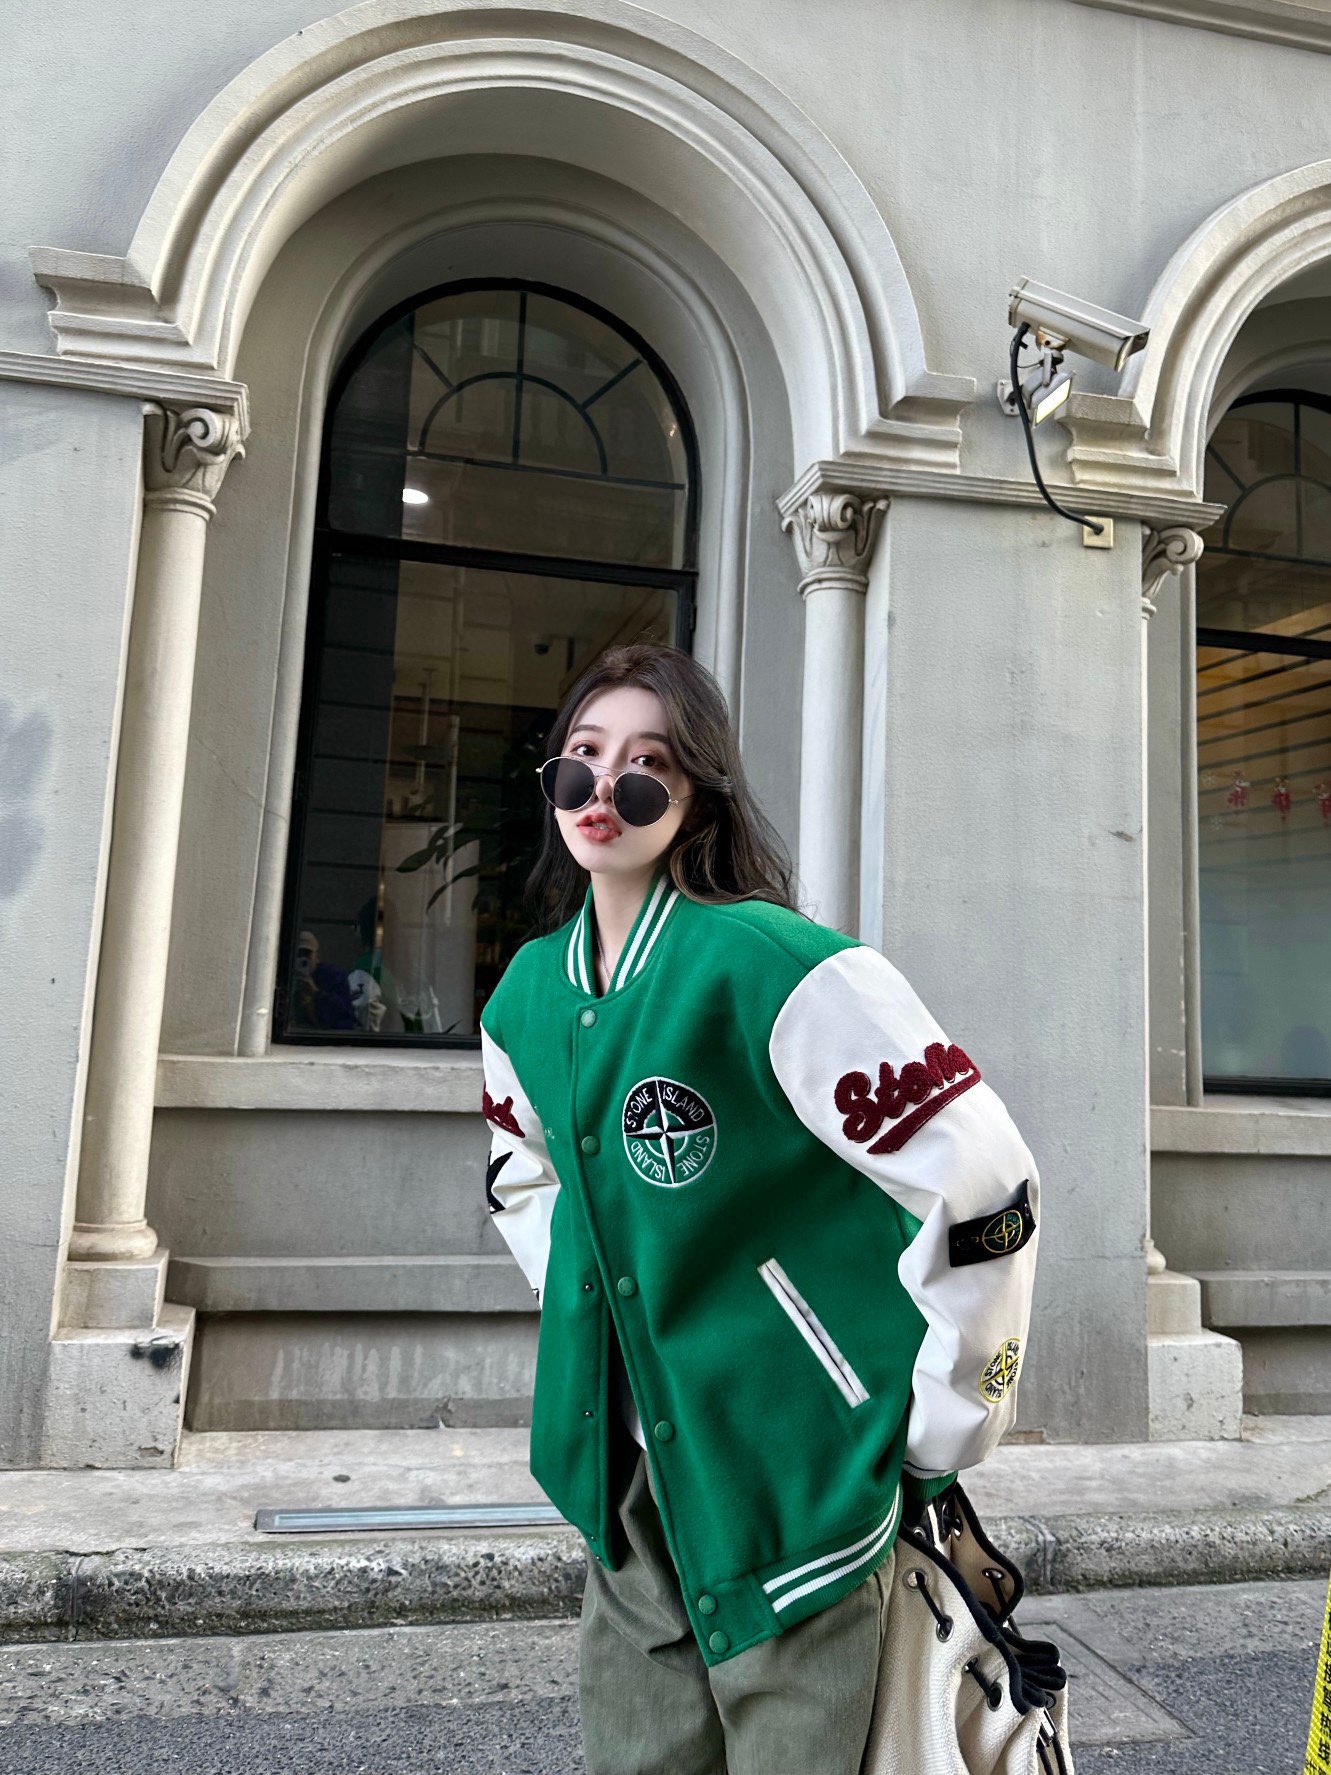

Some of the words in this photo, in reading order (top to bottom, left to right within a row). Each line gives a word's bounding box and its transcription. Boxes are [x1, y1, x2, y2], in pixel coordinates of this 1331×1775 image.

[626, 1087, 653, 1128] STONE
[662, 1084, 705, 1122] ISLAND
[630, 1141, 666, 1181] ISLAND
[676, 1134, 710, 1176] STONE
